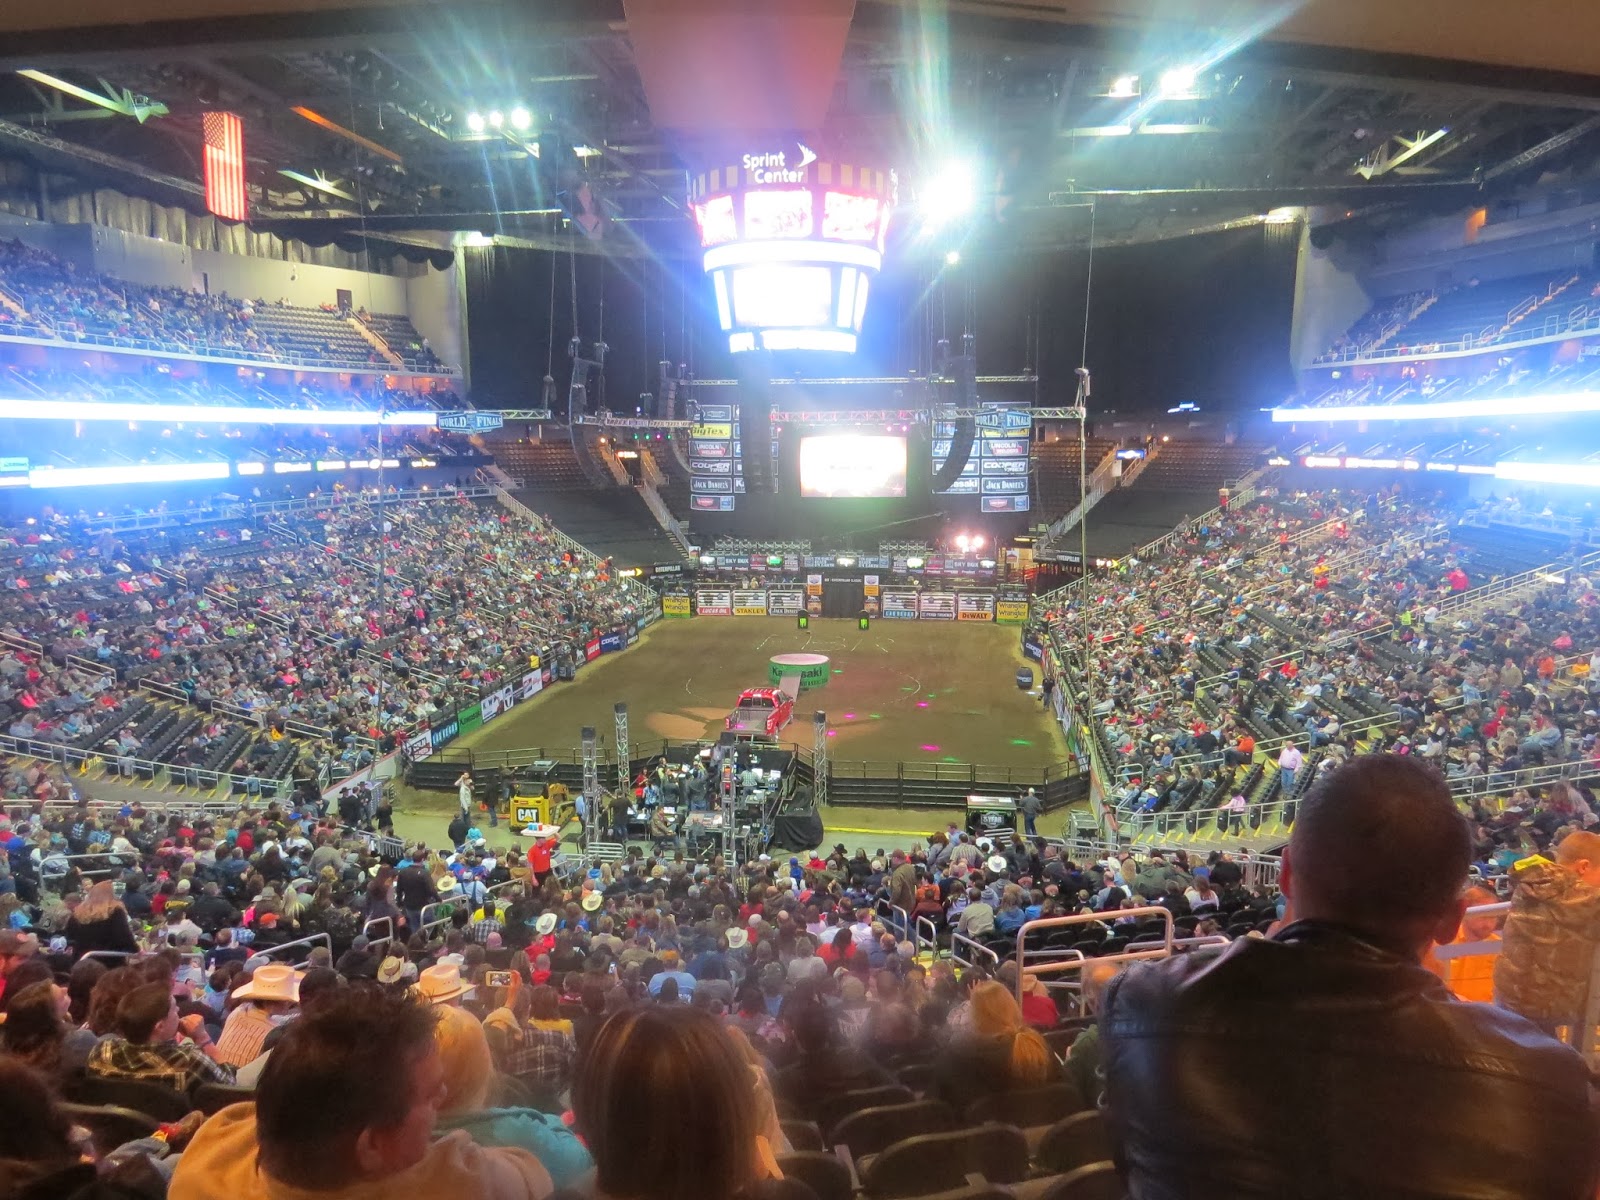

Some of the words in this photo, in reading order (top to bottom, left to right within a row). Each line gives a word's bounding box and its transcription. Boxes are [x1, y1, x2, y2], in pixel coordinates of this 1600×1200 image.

[743, 151, 785, 171] Sprint
[754, 168, 804, 184] Center
[440, 416, 467, 428] WORLD
[476, 416, 502, 427] FINALS
[976, 414, 998, 426] WORLD
[1007, 413, 1031, 427] FINALS
[694, 480, 707, 488] JACK
[986, 480, 1001, 489] JACK
[998, 601, 1026, 610] Wrangler
[962, 612, 988, 620] DeWALT
[998, 609, 1026, 618] Wrangler
[772, 666, 823, 679] Kasaki
[517, 808, 538, 822] CAT
